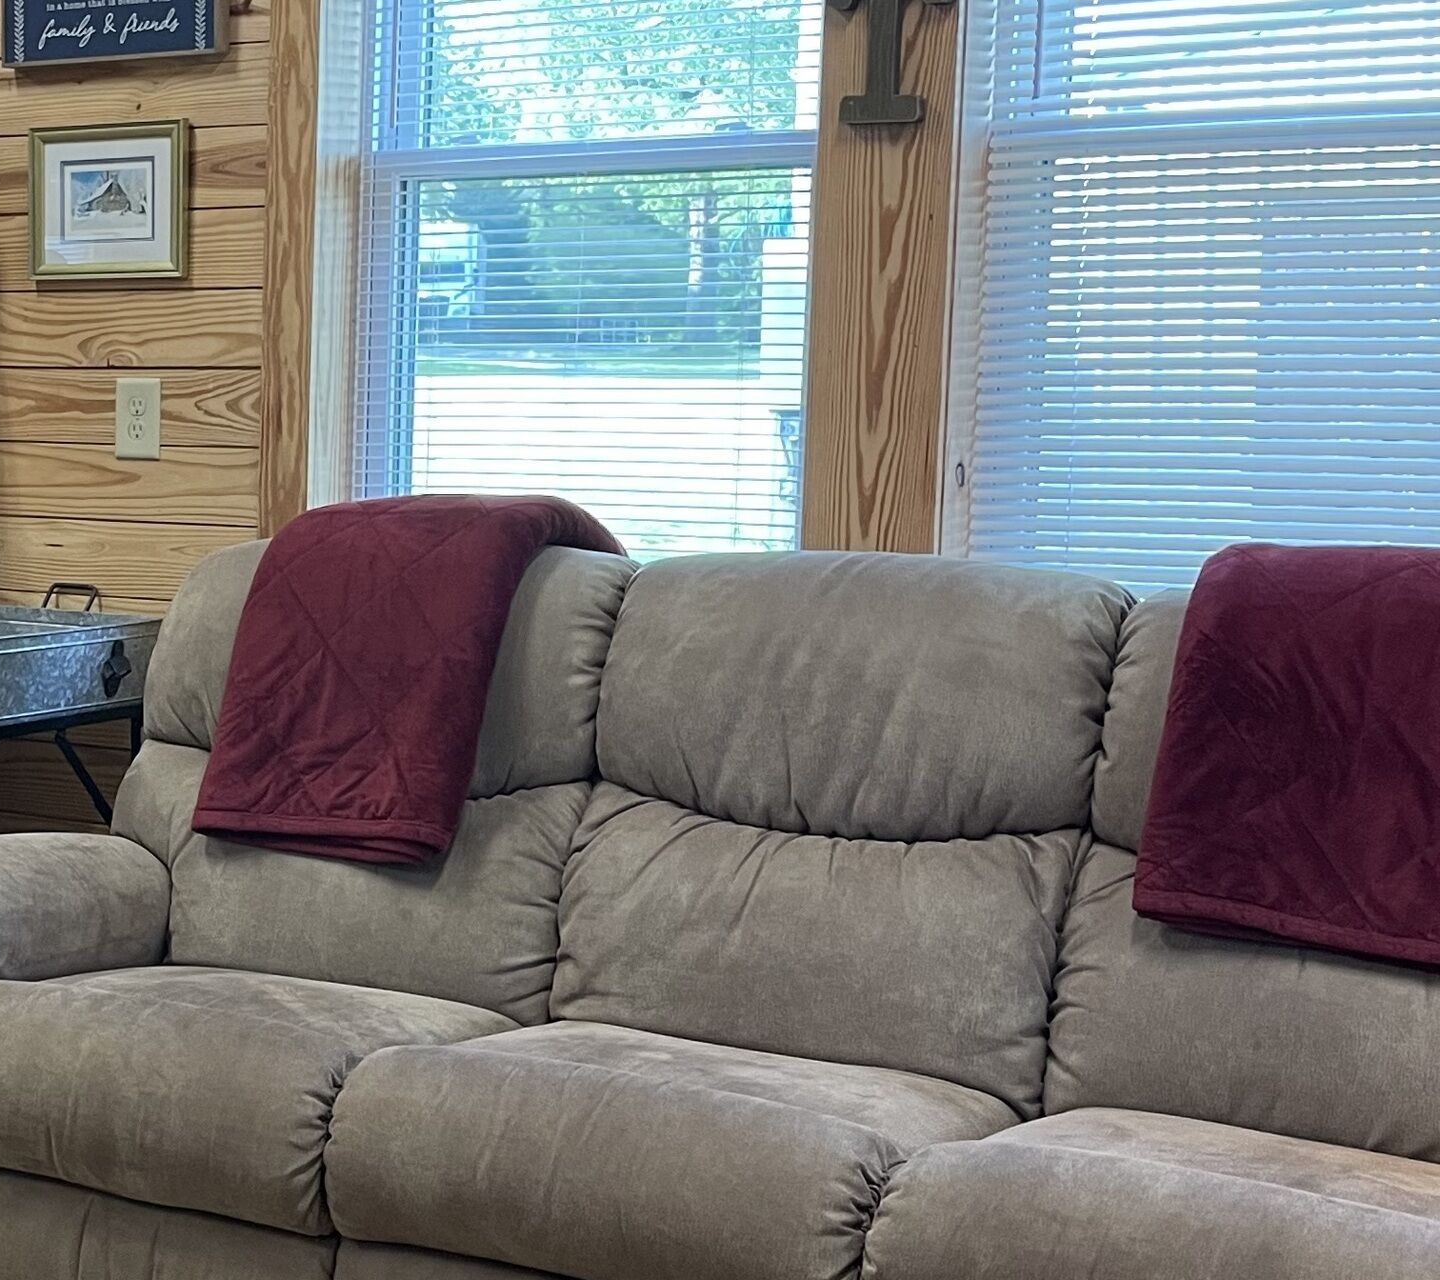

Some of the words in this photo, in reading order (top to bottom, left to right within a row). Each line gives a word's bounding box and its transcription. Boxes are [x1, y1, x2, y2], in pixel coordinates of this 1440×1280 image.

[46, 3, 55, 12] in
[64, 0, 87, 11] home
[88, 0, 106, 9] that
[37, 14, 97, 50] family
[103, 12, 117, 35] &
[119, 7, 181, 45] friends
